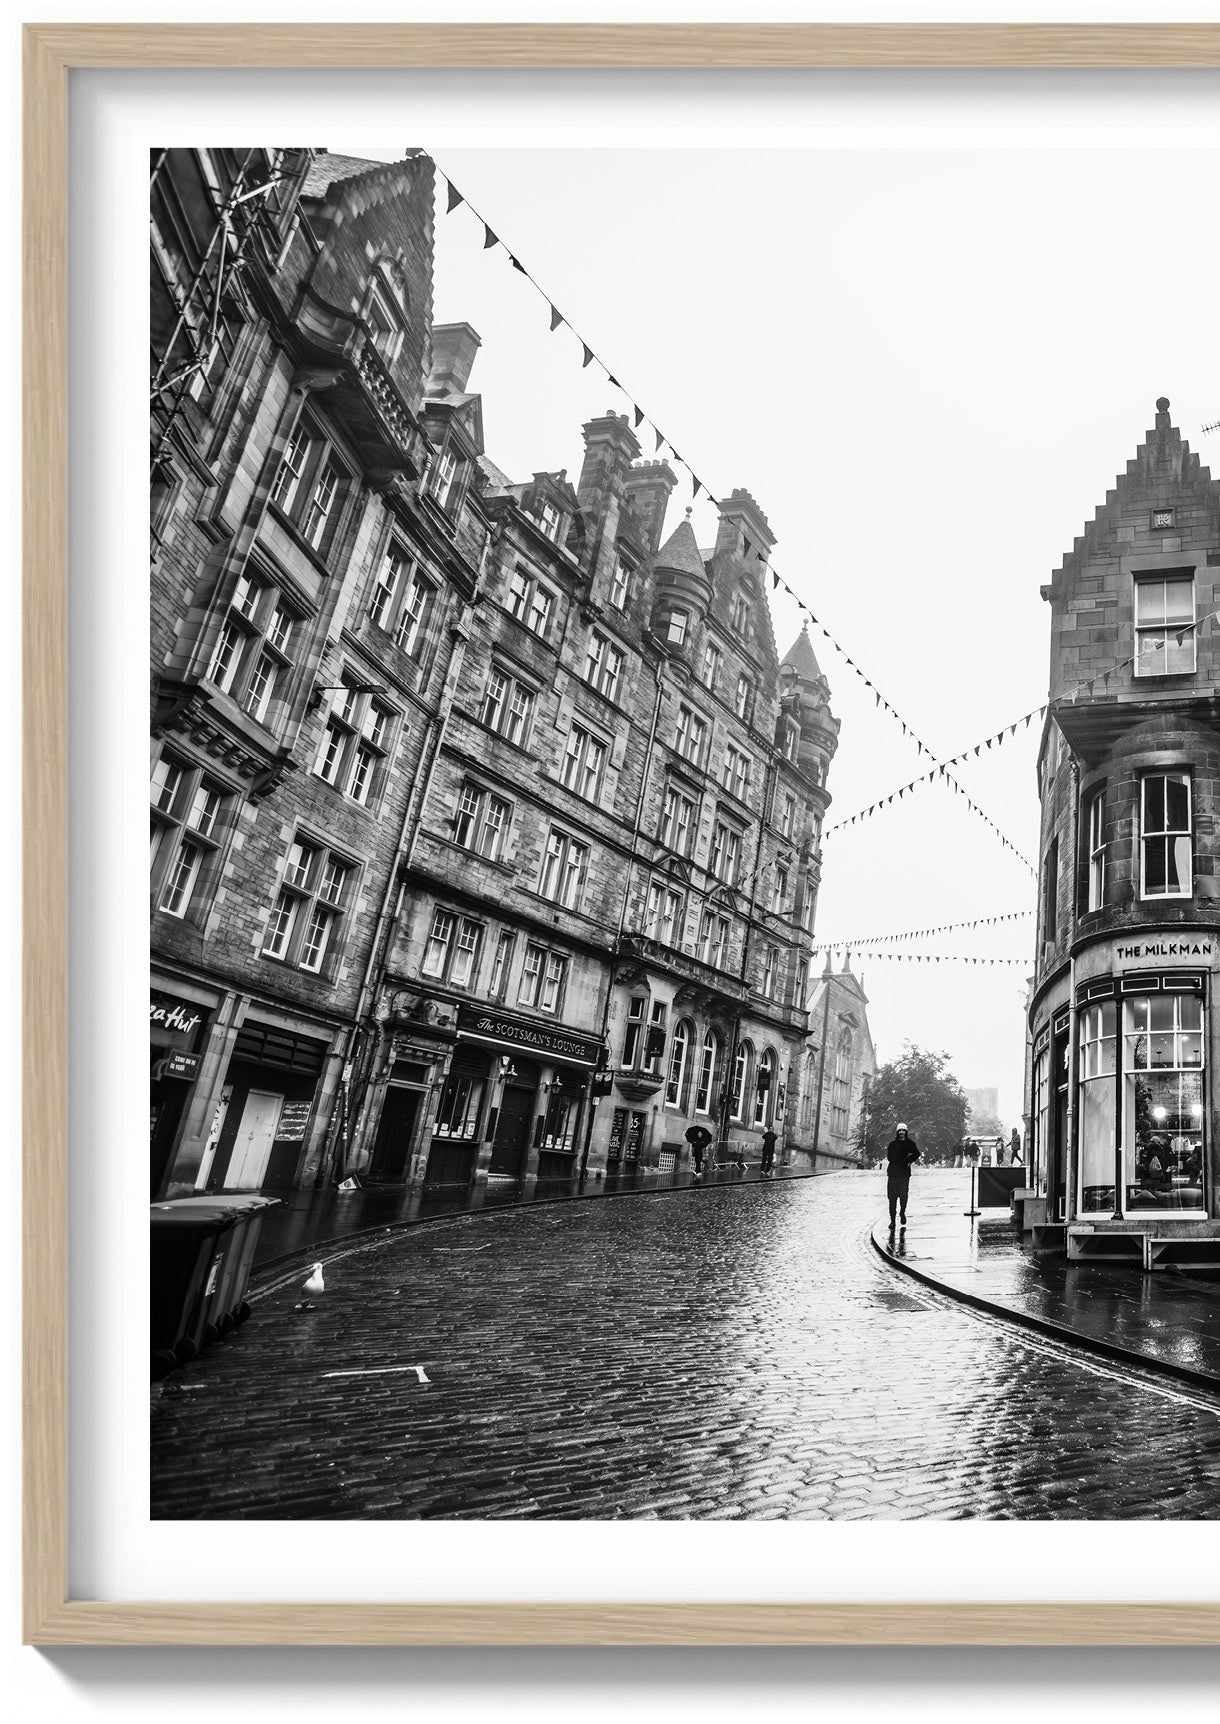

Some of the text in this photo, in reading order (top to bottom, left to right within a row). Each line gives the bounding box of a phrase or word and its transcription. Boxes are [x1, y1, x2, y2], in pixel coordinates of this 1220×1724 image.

[1117, 943, 1212, 959] THE MILKMAN
[164, 1006, 202, 1034] Hut
[477, 1018, 586, 1056] The SCOTSMAN'S LOUNGE
